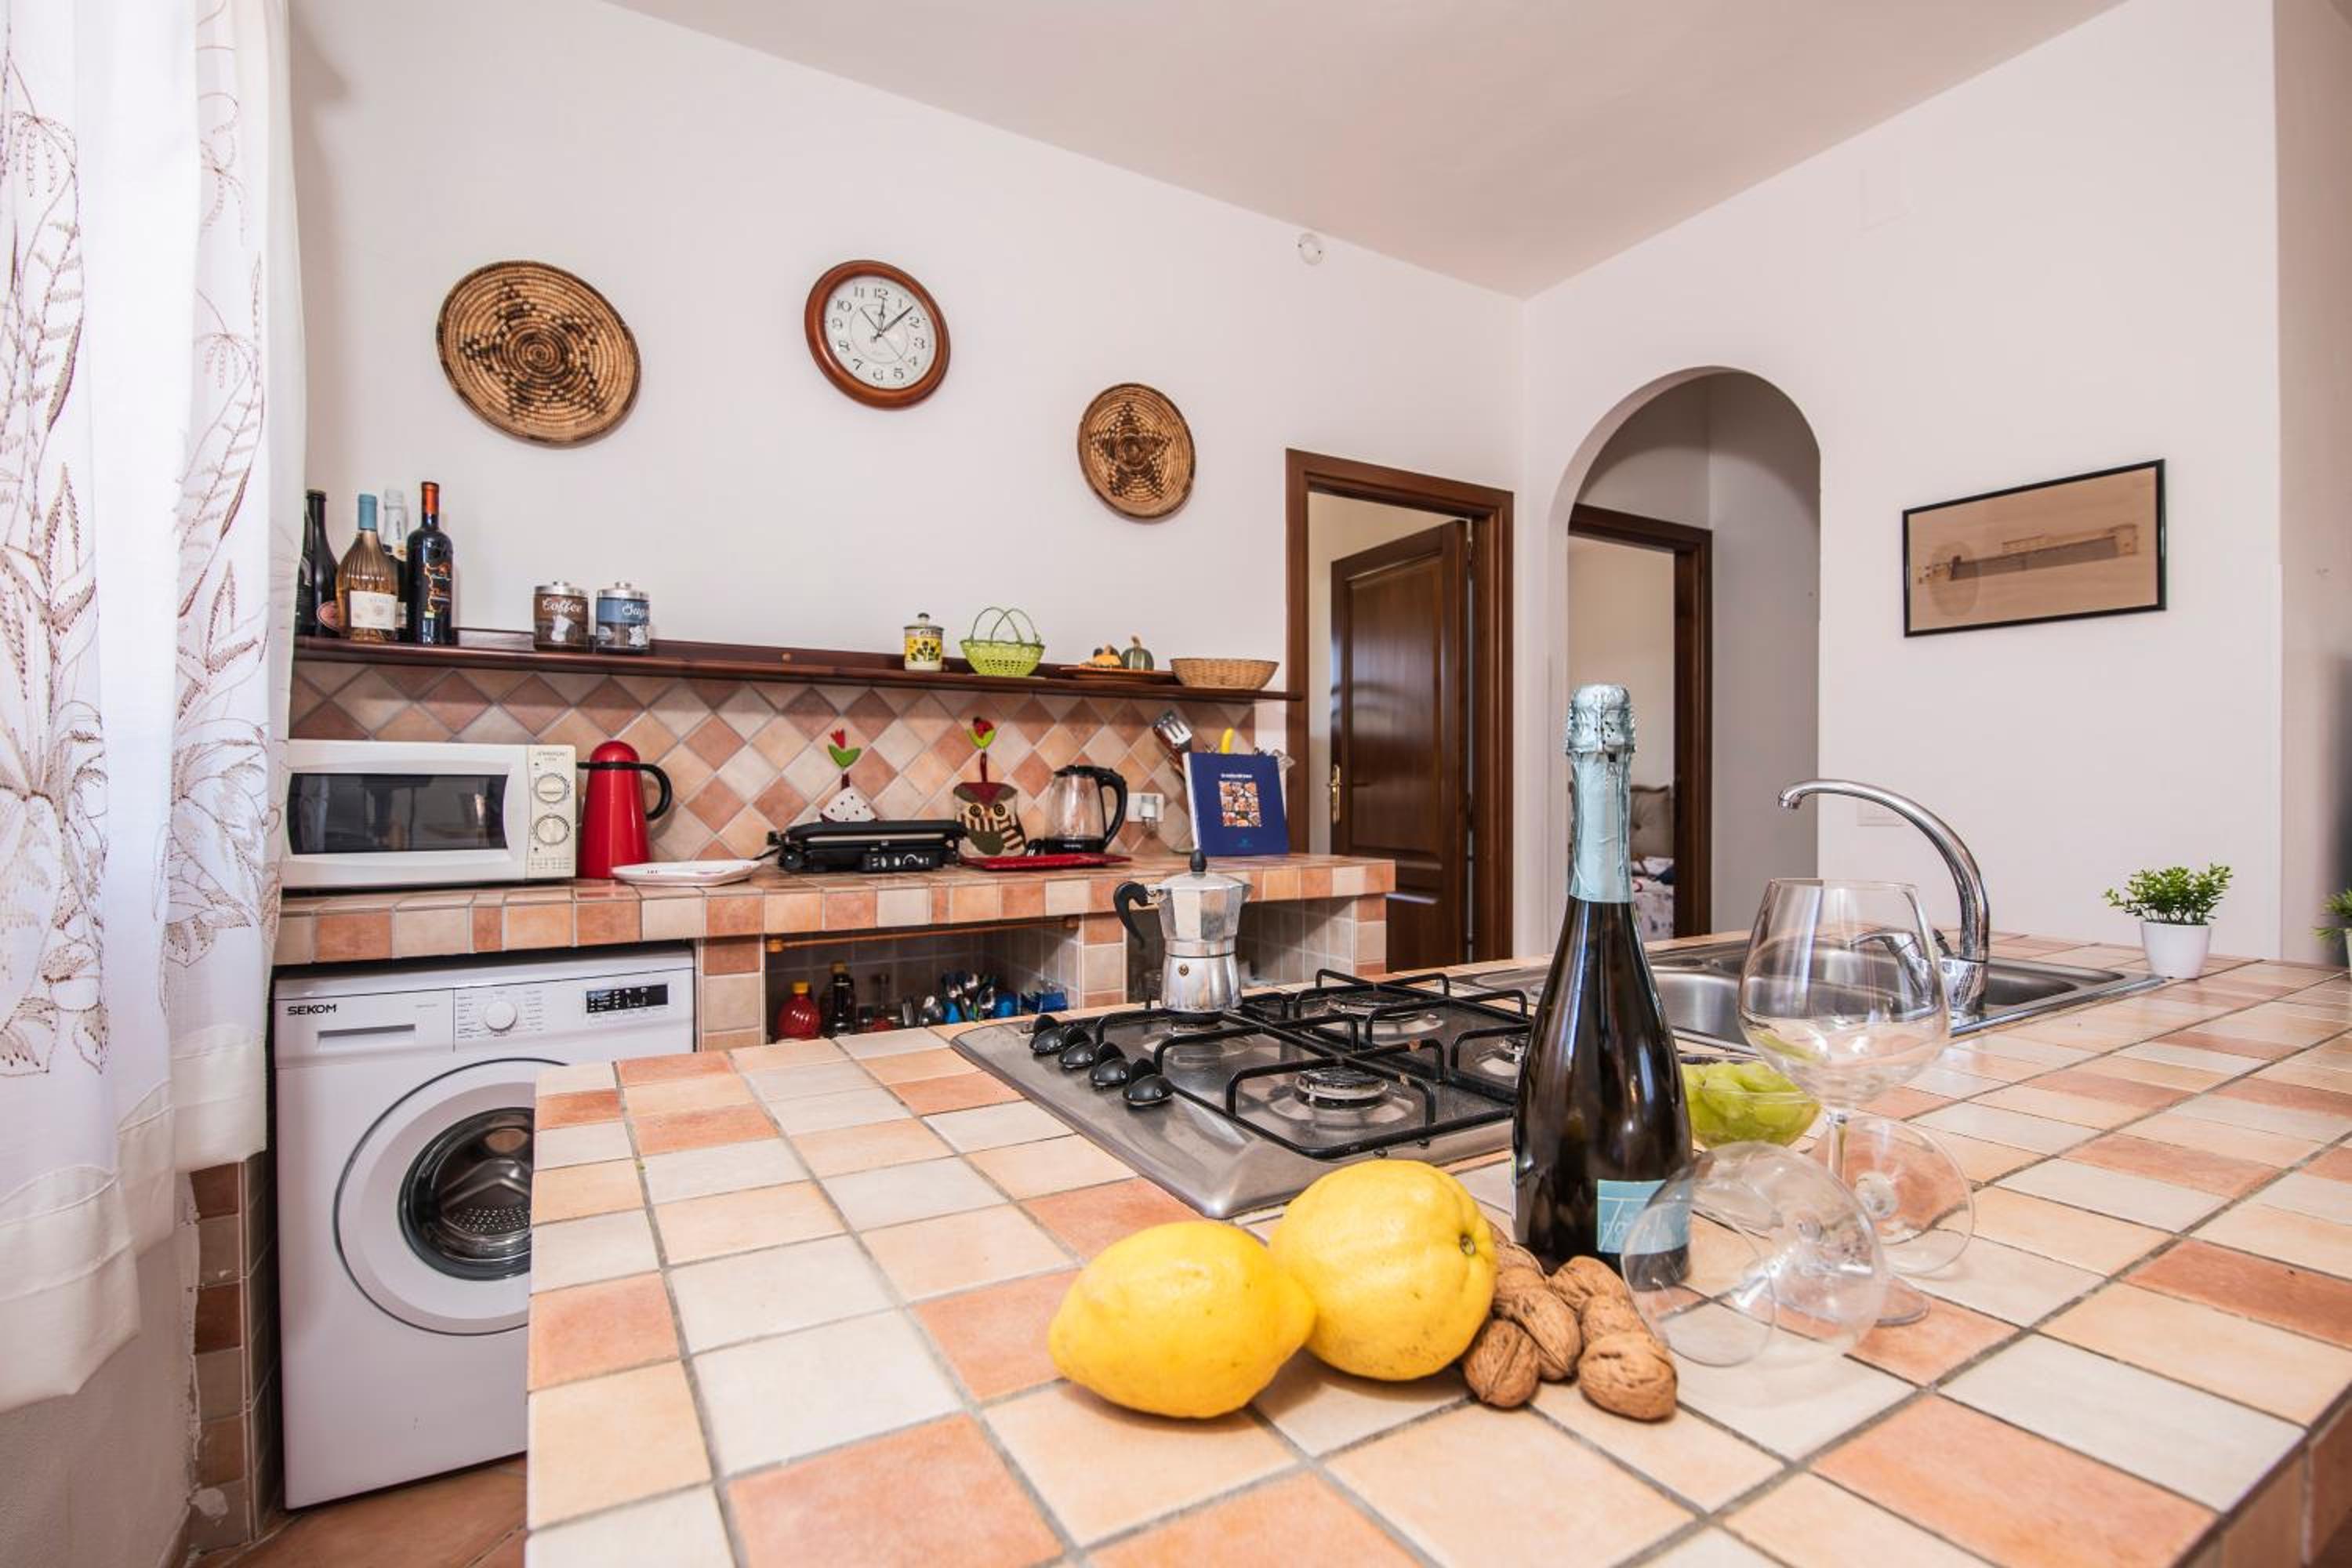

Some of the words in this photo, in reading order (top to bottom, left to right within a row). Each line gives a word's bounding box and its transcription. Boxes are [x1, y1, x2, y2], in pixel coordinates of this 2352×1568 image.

[854, 286, 865, 298] 11
[874, 288, 888, 301] 12
[837, 299, 852, 313] 10
[909, 316, 920, 328] 2
[913, 337, 925, 350] 3
[852, 358, 864, 371] 7
[894, 368, 904, 379] 5
[542, 597, 583, 613] Coffee
[287, 1004, 337, 1016] SEKOM
